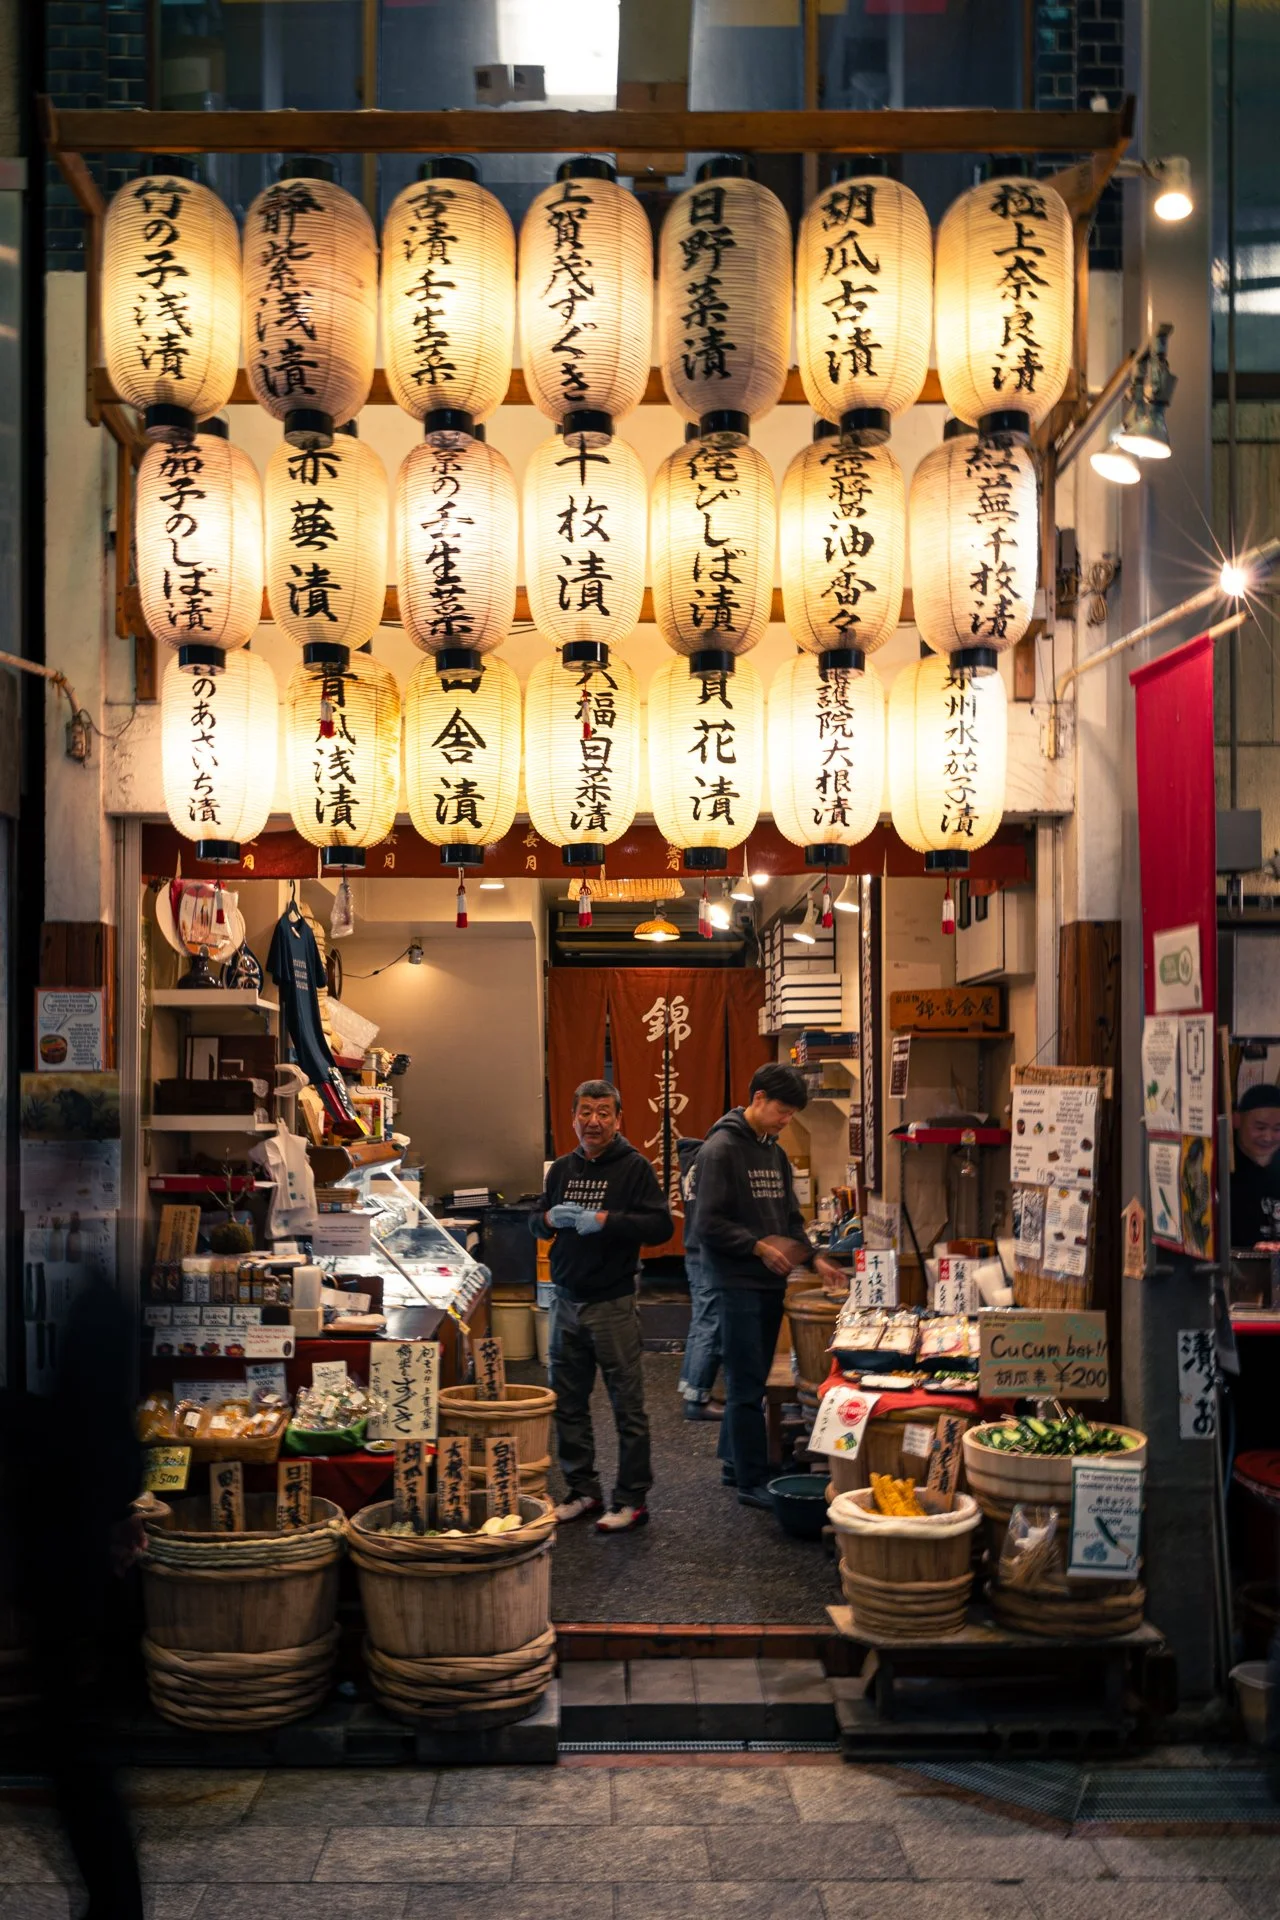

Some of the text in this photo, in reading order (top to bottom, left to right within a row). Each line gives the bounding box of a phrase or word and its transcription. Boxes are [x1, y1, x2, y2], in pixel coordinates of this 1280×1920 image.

[134, 179, 191, 380] 竹の子浅漬
[405, 186, 458, 386] 古漬壬生菜
[540, 181, 598, 402] 上賀茂すぐき
[679, 186, 736, 381] 日野菜漬
[822, 184, 882, 384] 胡瓜古漬
[989, 184, 1050, 392] 極上奈良漬
[158, 440, 217, 631] 茄子のしば漬
[286, 438, 342, 623] 赤蕪漬
[554, 434, 613, 617] 千枚漬
[188, 667, 220, 825] のあさいち漬
[522, 831, 540, 871] 長月
[867, 1255, 887, 1304] 千枚漬
[1052, 1360, 1108, 1393] ¥200
